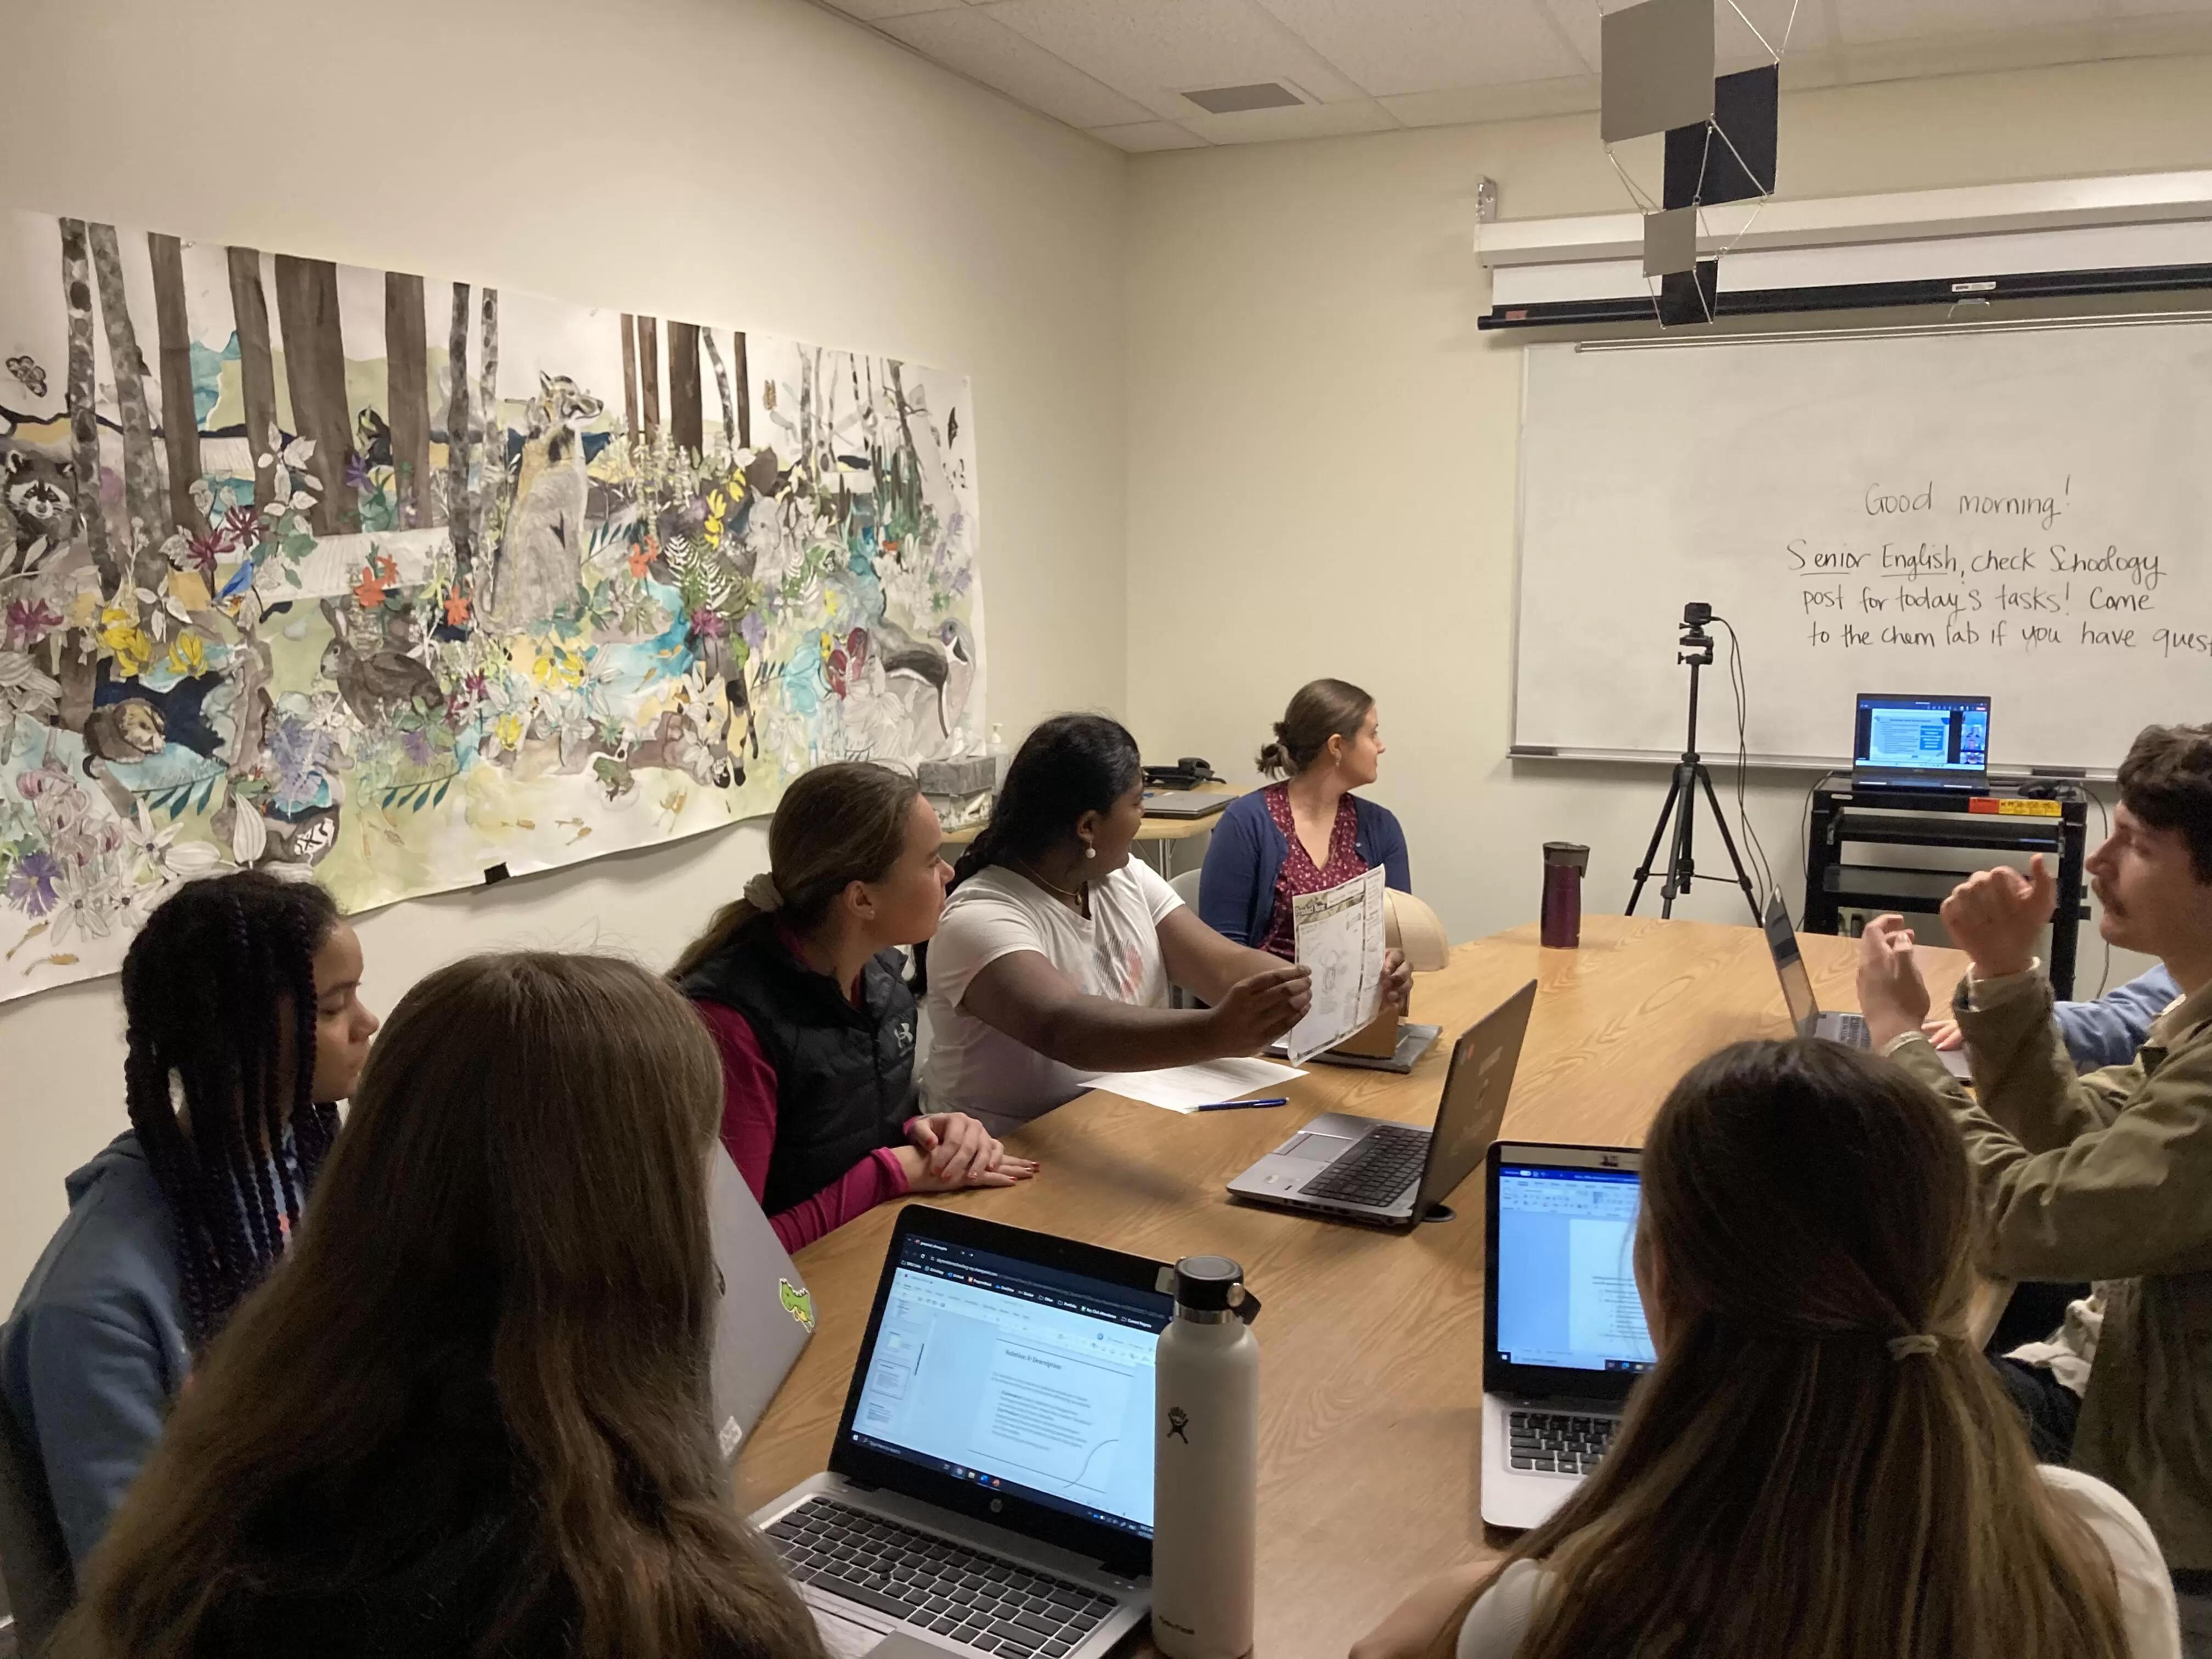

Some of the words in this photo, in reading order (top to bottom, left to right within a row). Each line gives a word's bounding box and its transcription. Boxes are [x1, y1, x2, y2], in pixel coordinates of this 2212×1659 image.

[1865, 480, 1932, 516] Good
[1959, 473, 2071, 531] morning!
[1787, 539, 1871, 571] Senior
[1971, 547, 2035, 572] check
[2050, 545, 2168, 591] Schoology
[1803, 584, 1846, 614] post
[1859, 586, 1889, 613] for
[1995, 582, 2070, 616] tasks!
[1807, 620, 1830, 647] to
[1840, 624, 1875, 648] the
[1881, 625, 1935, 648] chem
[1946, 620, 1979, 646] lab
[1991, 620, 2007, 646] if
[2022, 625, 2062, 653] you
[2081, 620, 2137, 648] have
